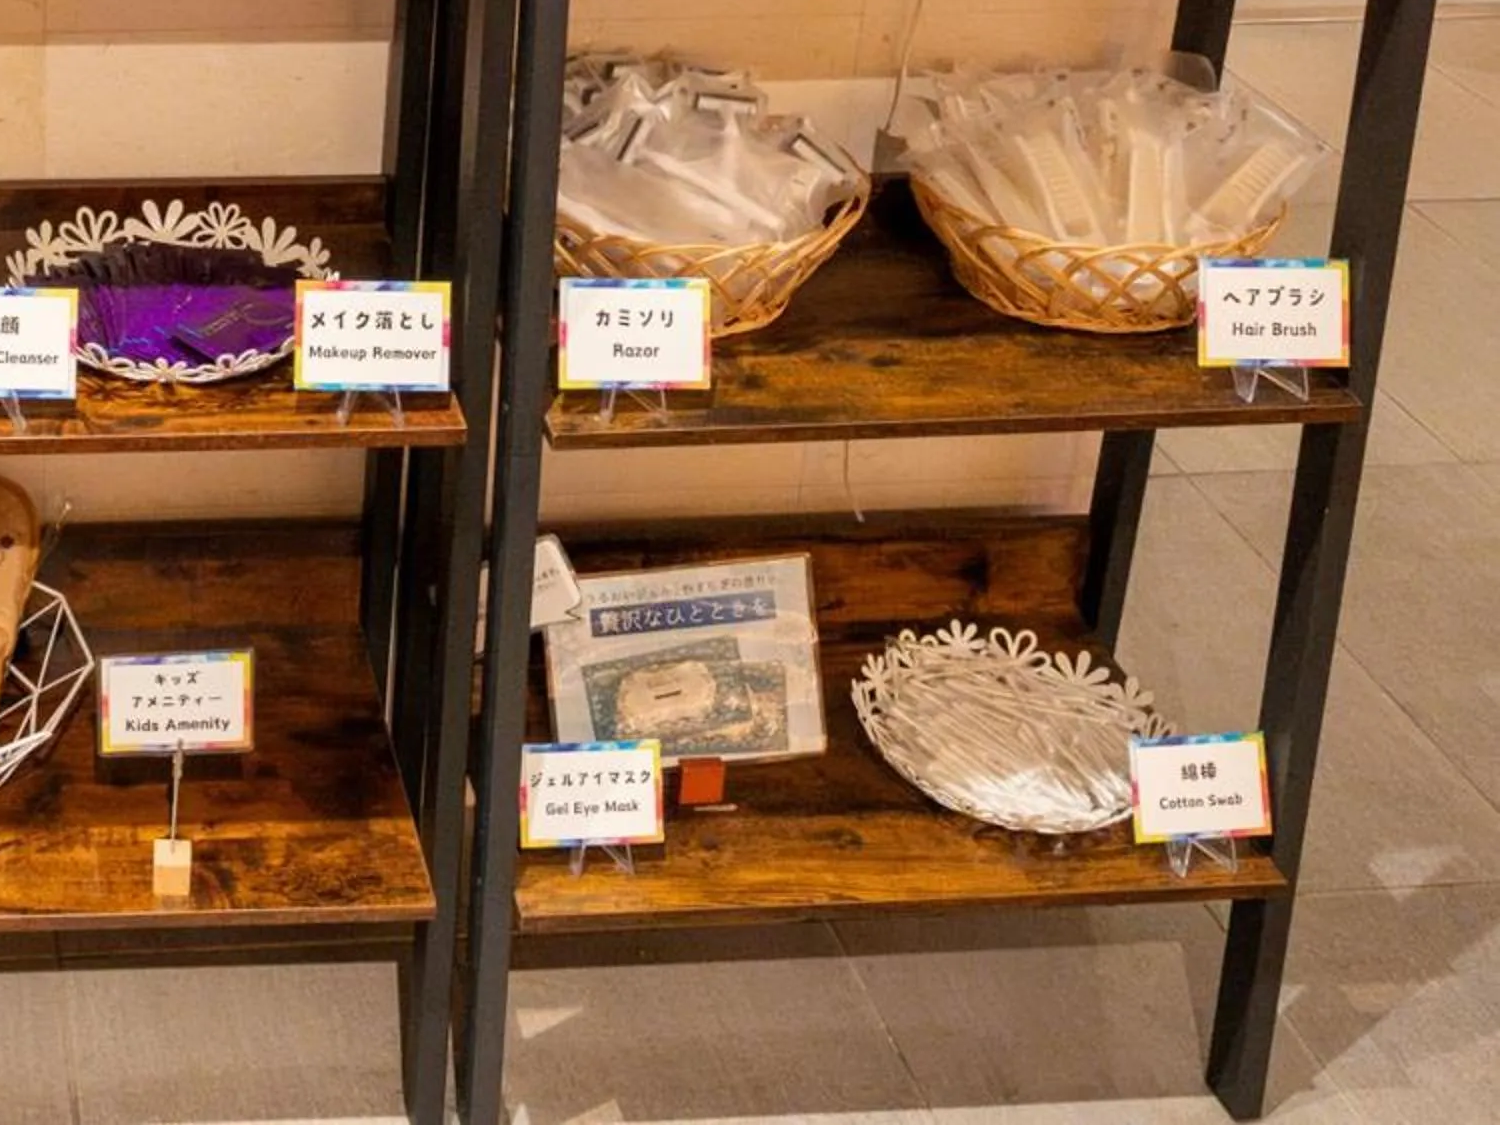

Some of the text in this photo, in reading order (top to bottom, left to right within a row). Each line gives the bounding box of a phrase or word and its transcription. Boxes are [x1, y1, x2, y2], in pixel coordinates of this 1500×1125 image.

[1223, 286, 1325, 306] ヘアブラシ
[311, 311, 434, 330] メイク落とし
[596, 309, 674, 328] カミソリ
[1232, 322, 1317, 337] Hair Brush
[309, 346, 436, 361] Makeup Remover
[613, 343, 660, 358] Razor
[155, 671, 203, 685] キッズ
[132, 695, 222, 708] アメニティー
[125, 718, 231, 731] Kids Amenity
[530, 770, 651, 788] ジェルアイマスク
[545, 799, 639, 820] Gel Eye Mask
[1159, 794, 1243, 810] Cotton Swab
